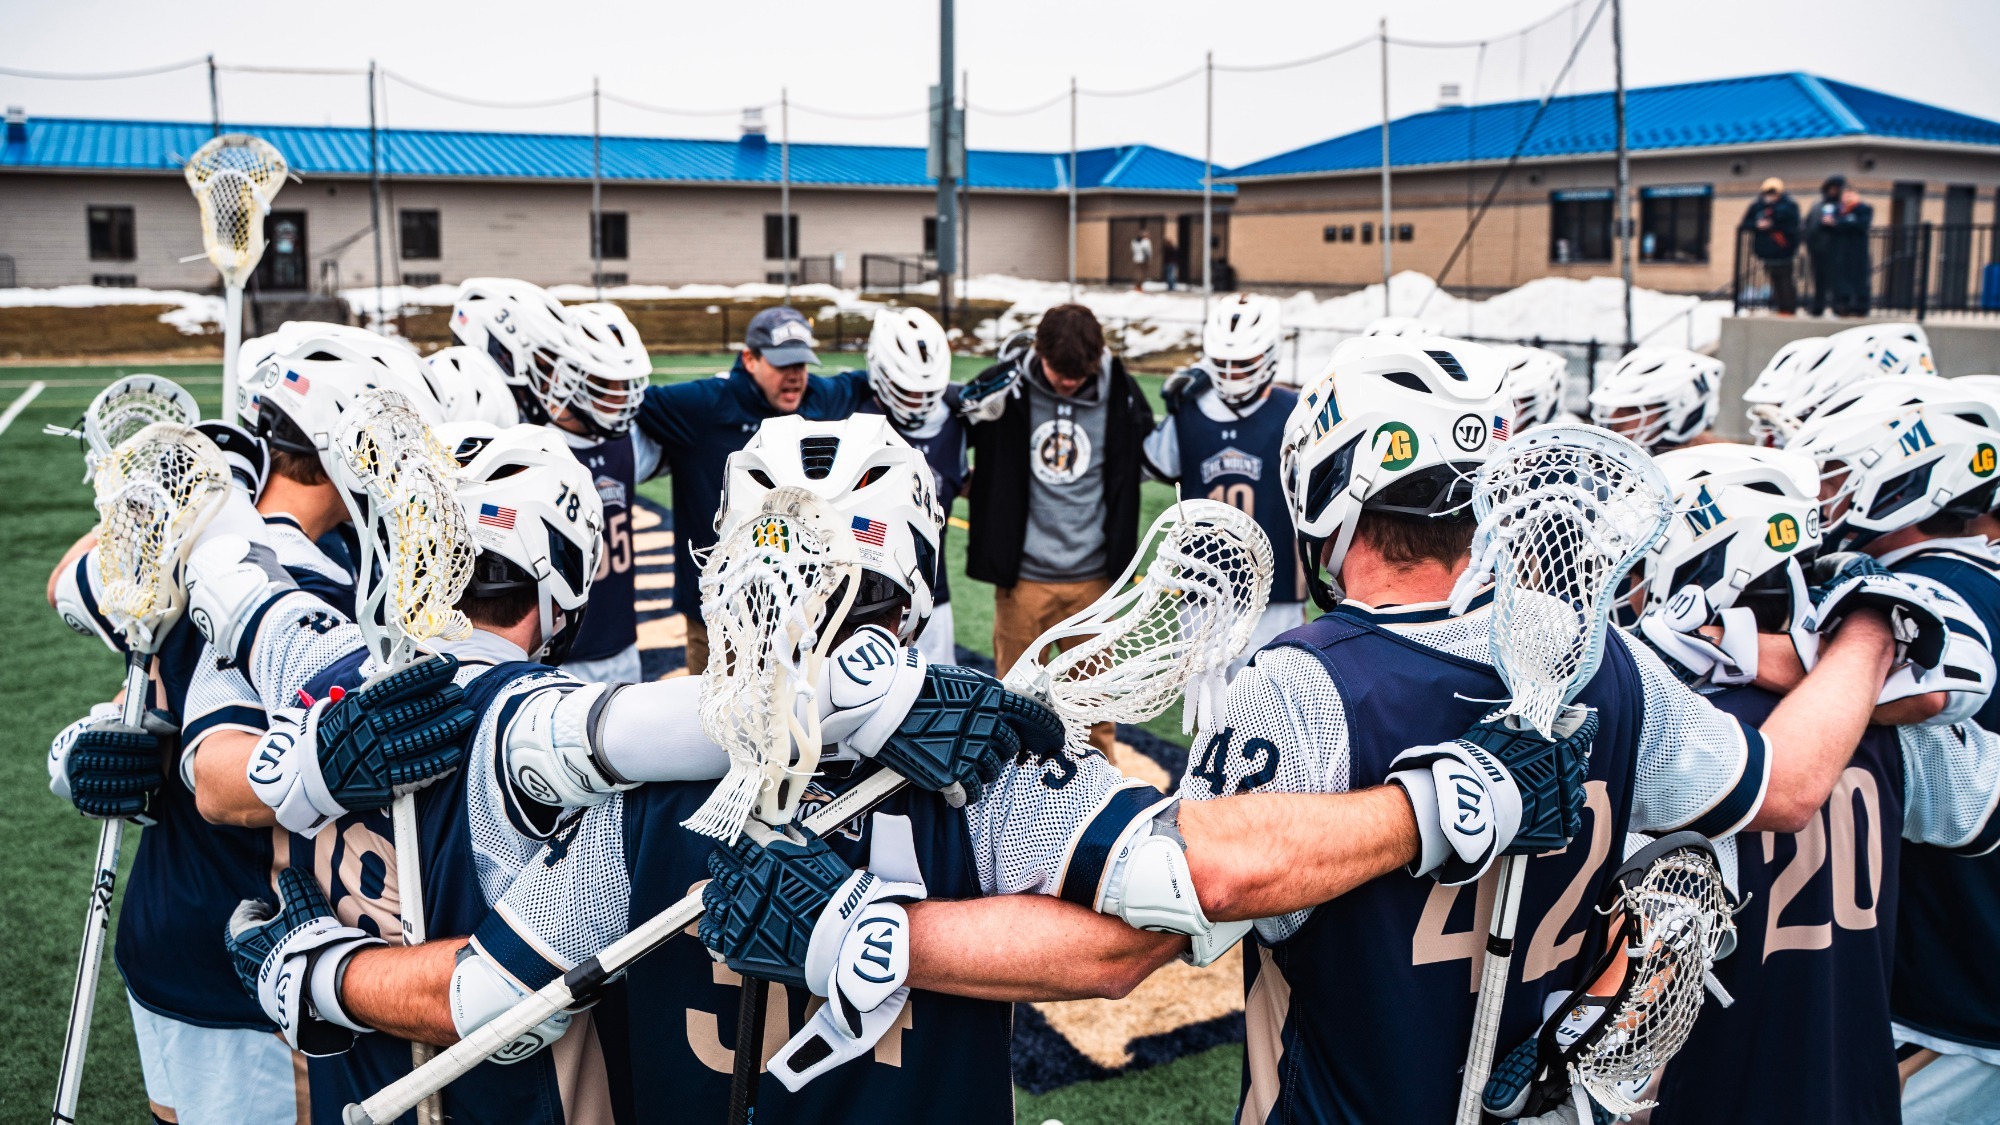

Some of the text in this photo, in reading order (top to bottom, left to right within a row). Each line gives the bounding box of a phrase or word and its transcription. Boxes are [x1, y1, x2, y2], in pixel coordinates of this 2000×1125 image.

[1971, 447, 1996, 474] LG
[555, 480, 581, 523] 78
[911, 471, 933, 520] 34
[1768, 518, 1798, 548] LG
[1192, 726, 1281, 797] 42
[1412, 779, 1613, 994] 42
[1761, 766, 1883, 966] 20
